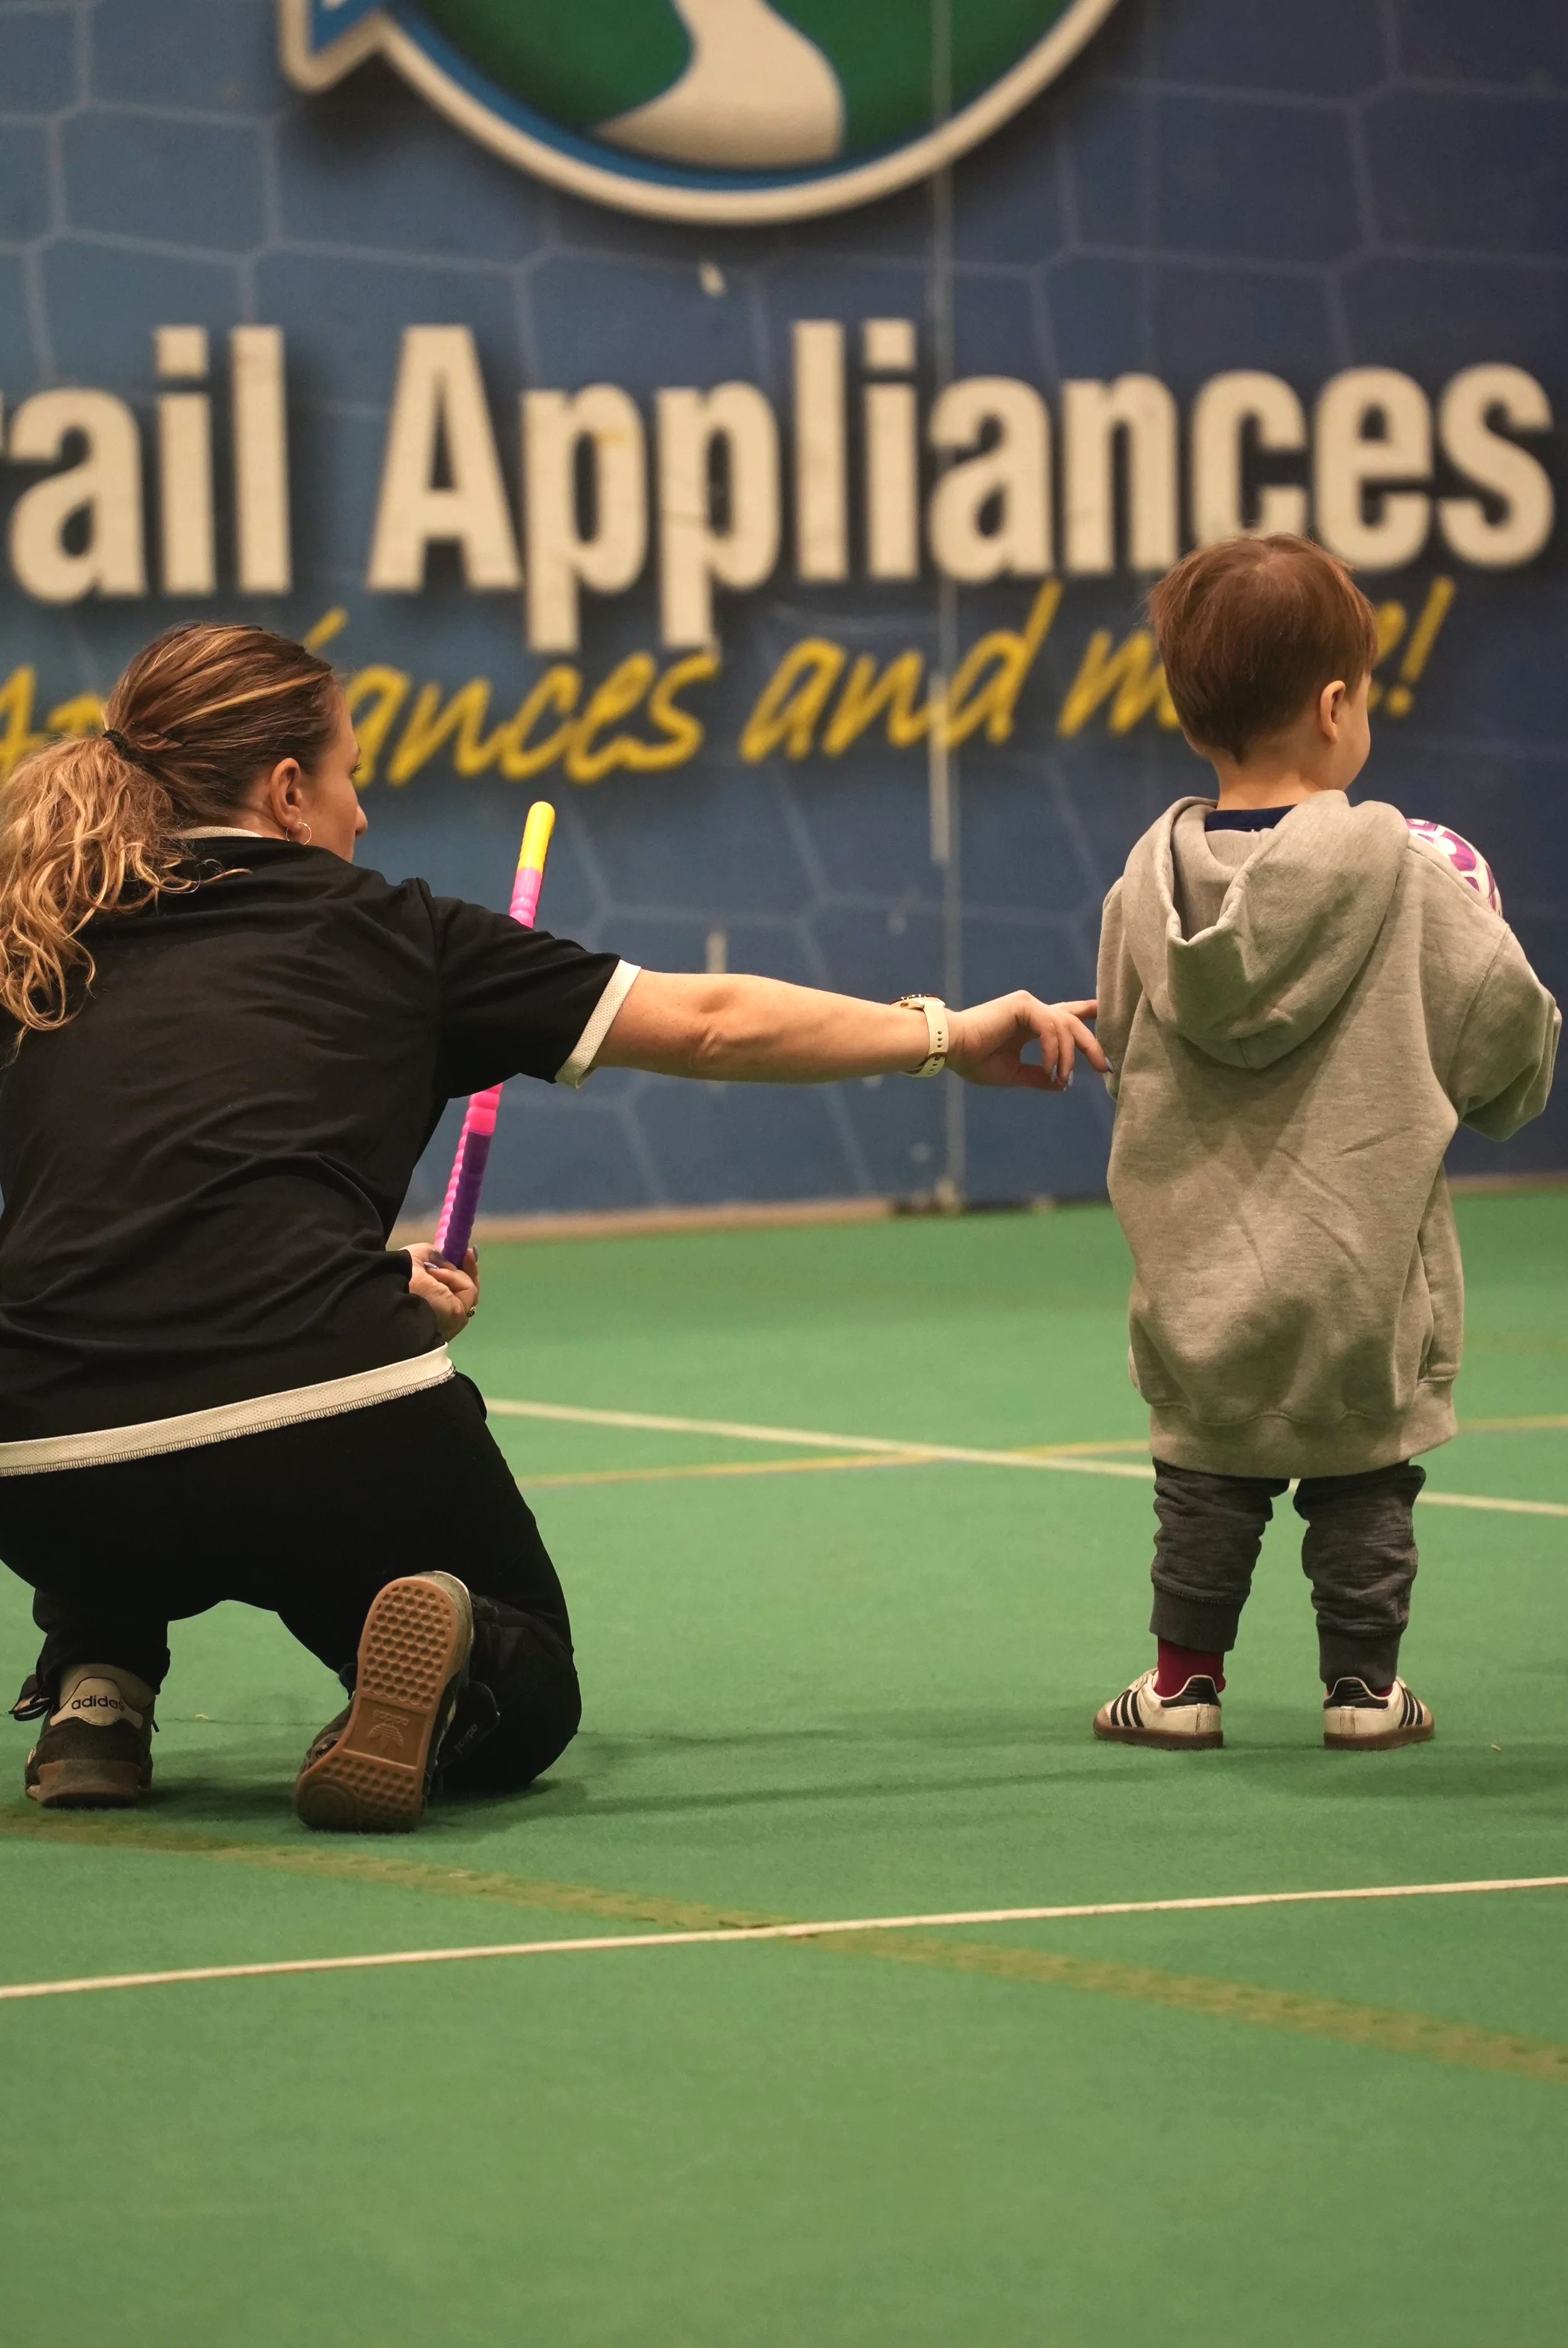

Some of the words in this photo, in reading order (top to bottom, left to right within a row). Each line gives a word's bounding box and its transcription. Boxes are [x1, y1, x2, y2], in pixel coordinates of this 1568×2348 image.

[0, 323, 292, 605] ail
[365, 317, 1555, 654] Appliances
[740, 578, 1062, 763] and
[72, 1695, 125, 1711] adidas
